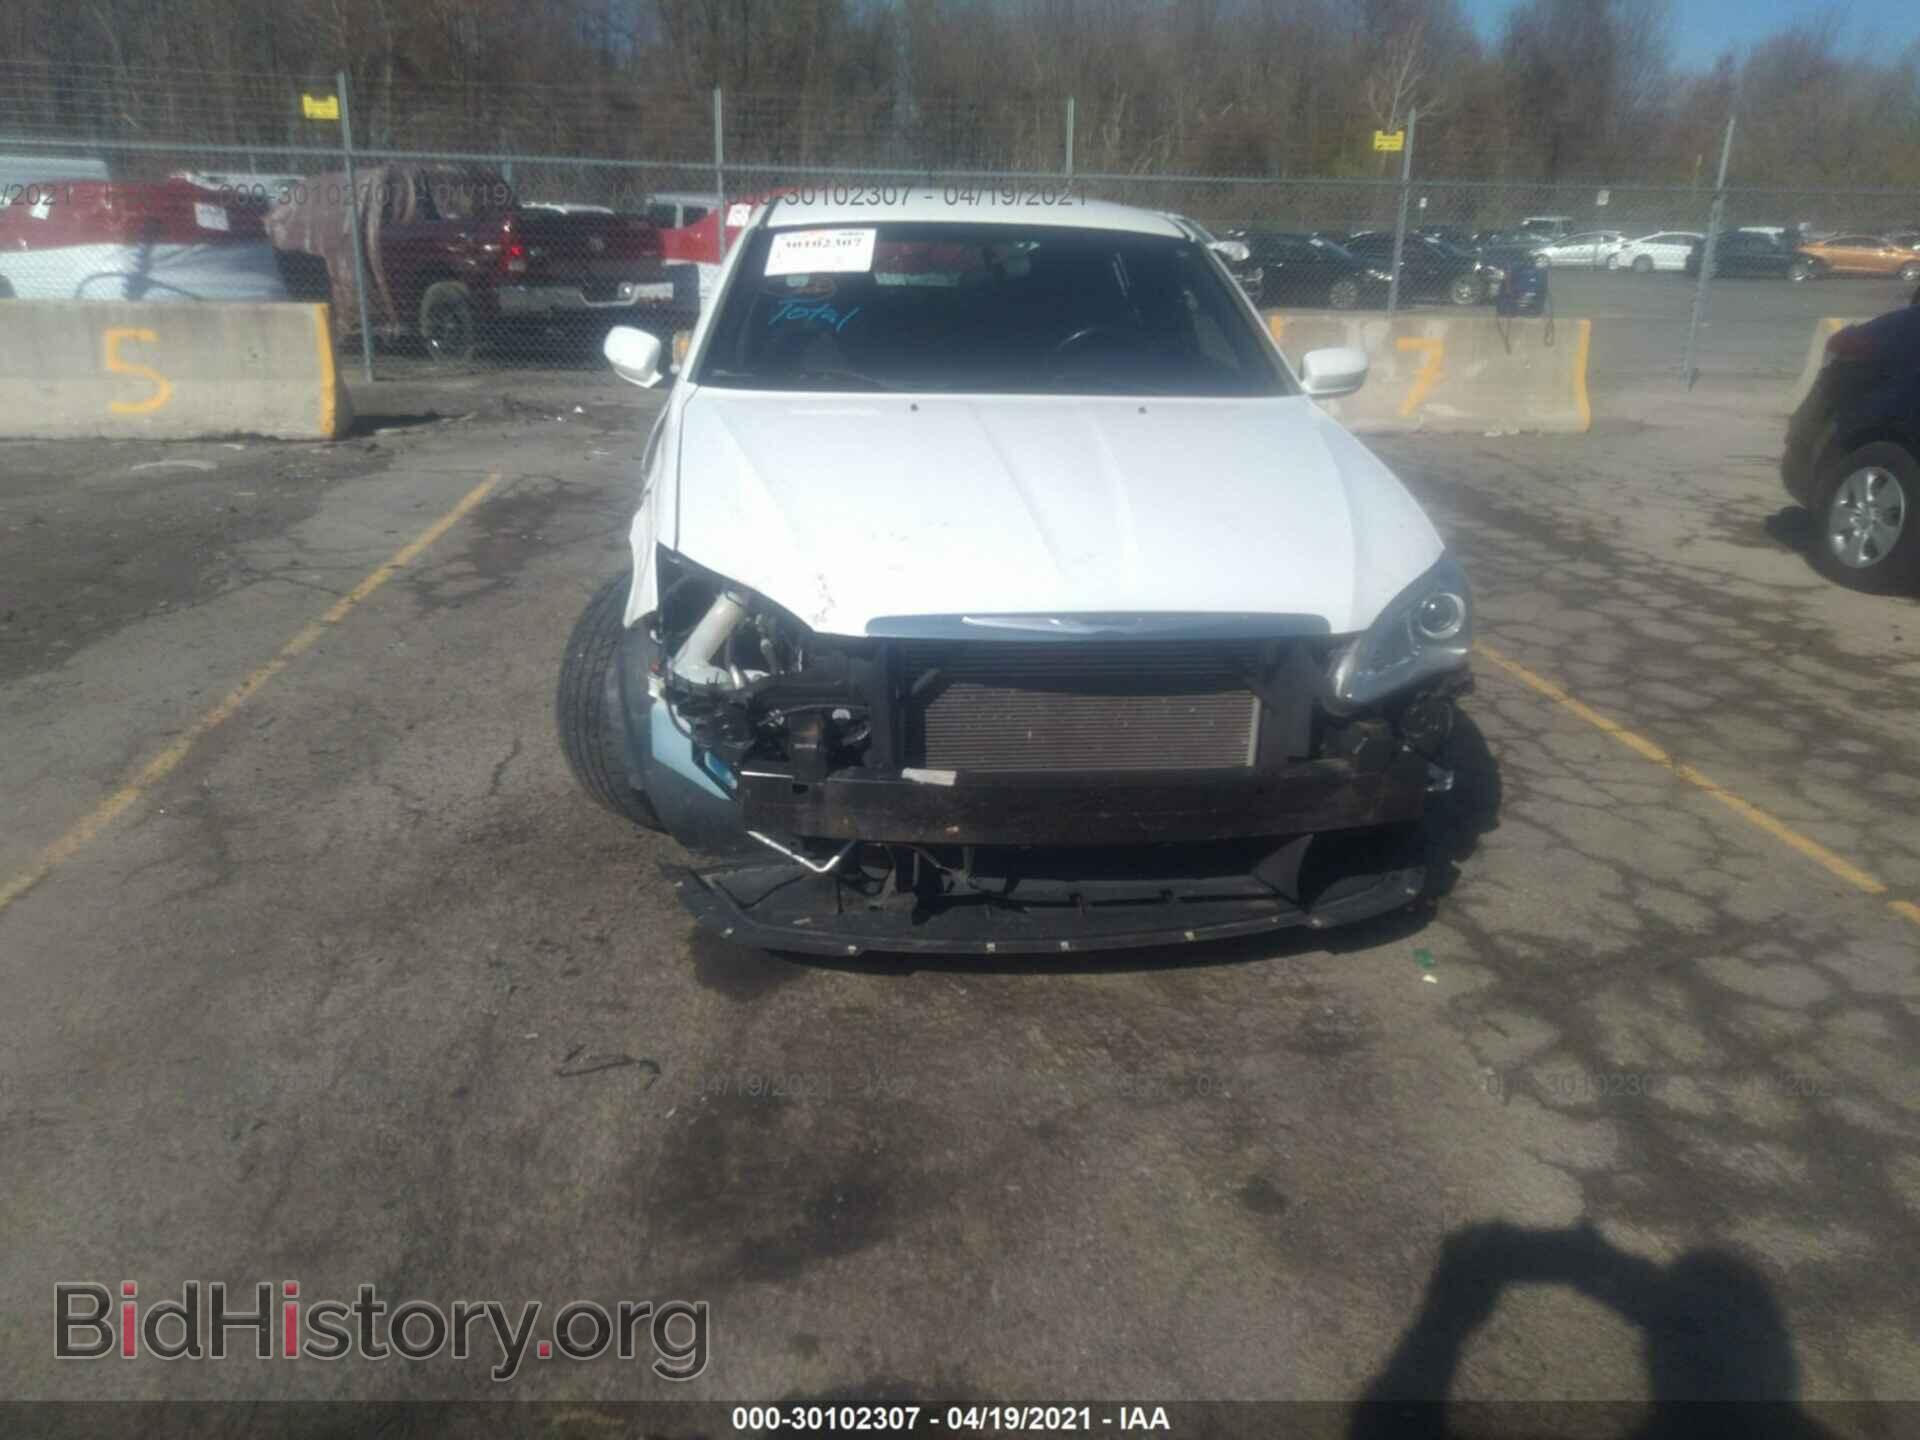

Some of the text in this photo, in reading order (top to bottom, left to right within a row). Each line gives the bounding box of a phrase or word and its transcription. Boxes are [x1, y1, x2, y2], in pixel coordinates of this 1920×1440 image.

[767, 299, 862, 332] Total
[101, 328, 173, 414] 5
[1396, 337, 1445, 416] 7
